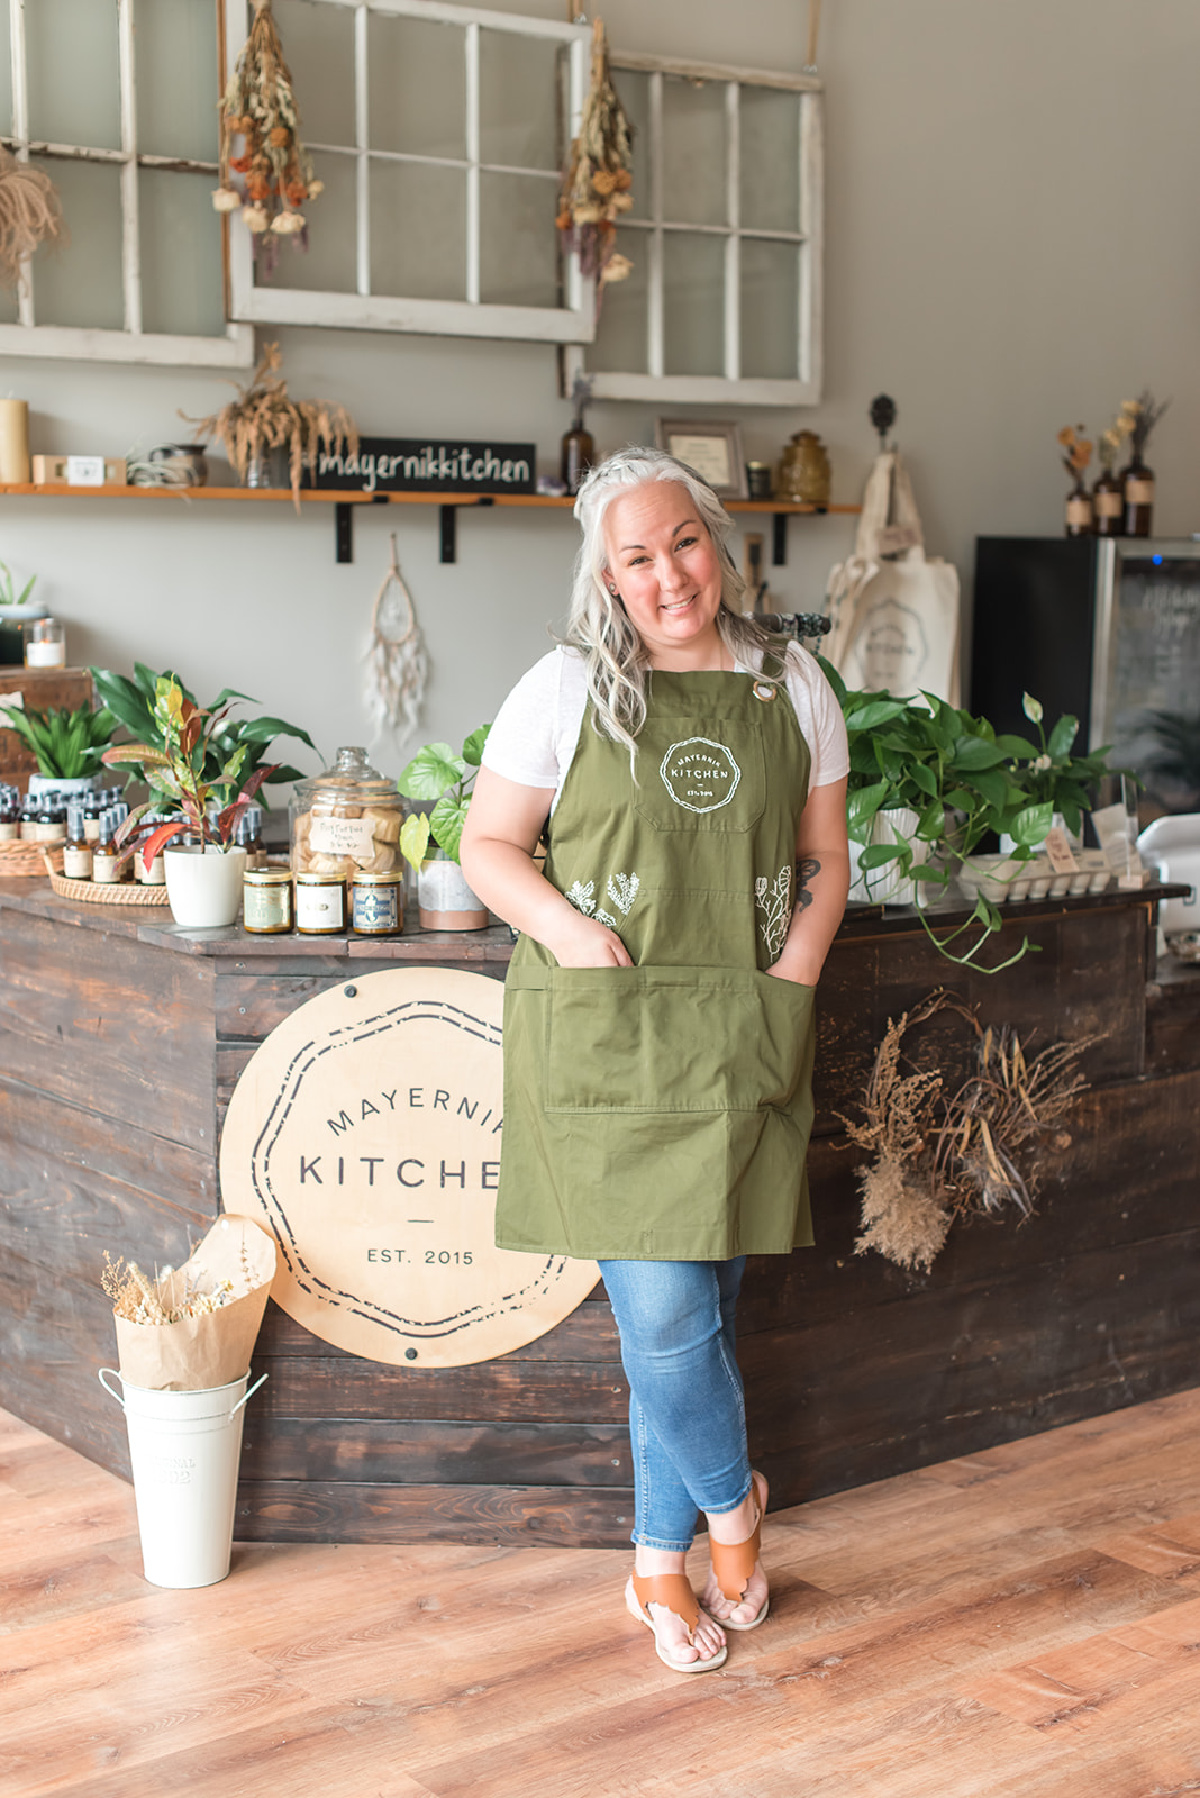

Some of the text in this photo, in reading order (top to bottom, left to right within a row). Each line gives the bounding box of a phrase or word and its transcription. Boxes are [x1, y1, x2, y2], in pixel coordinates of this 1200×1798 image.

[300, 446, 530, 492] mayernikkitchen
[671, 769, 728, 779] KITCHEN
[300, 1155, 501, 1189] KITCHE
[367, 1249, 473, 1265] EST. 2015
